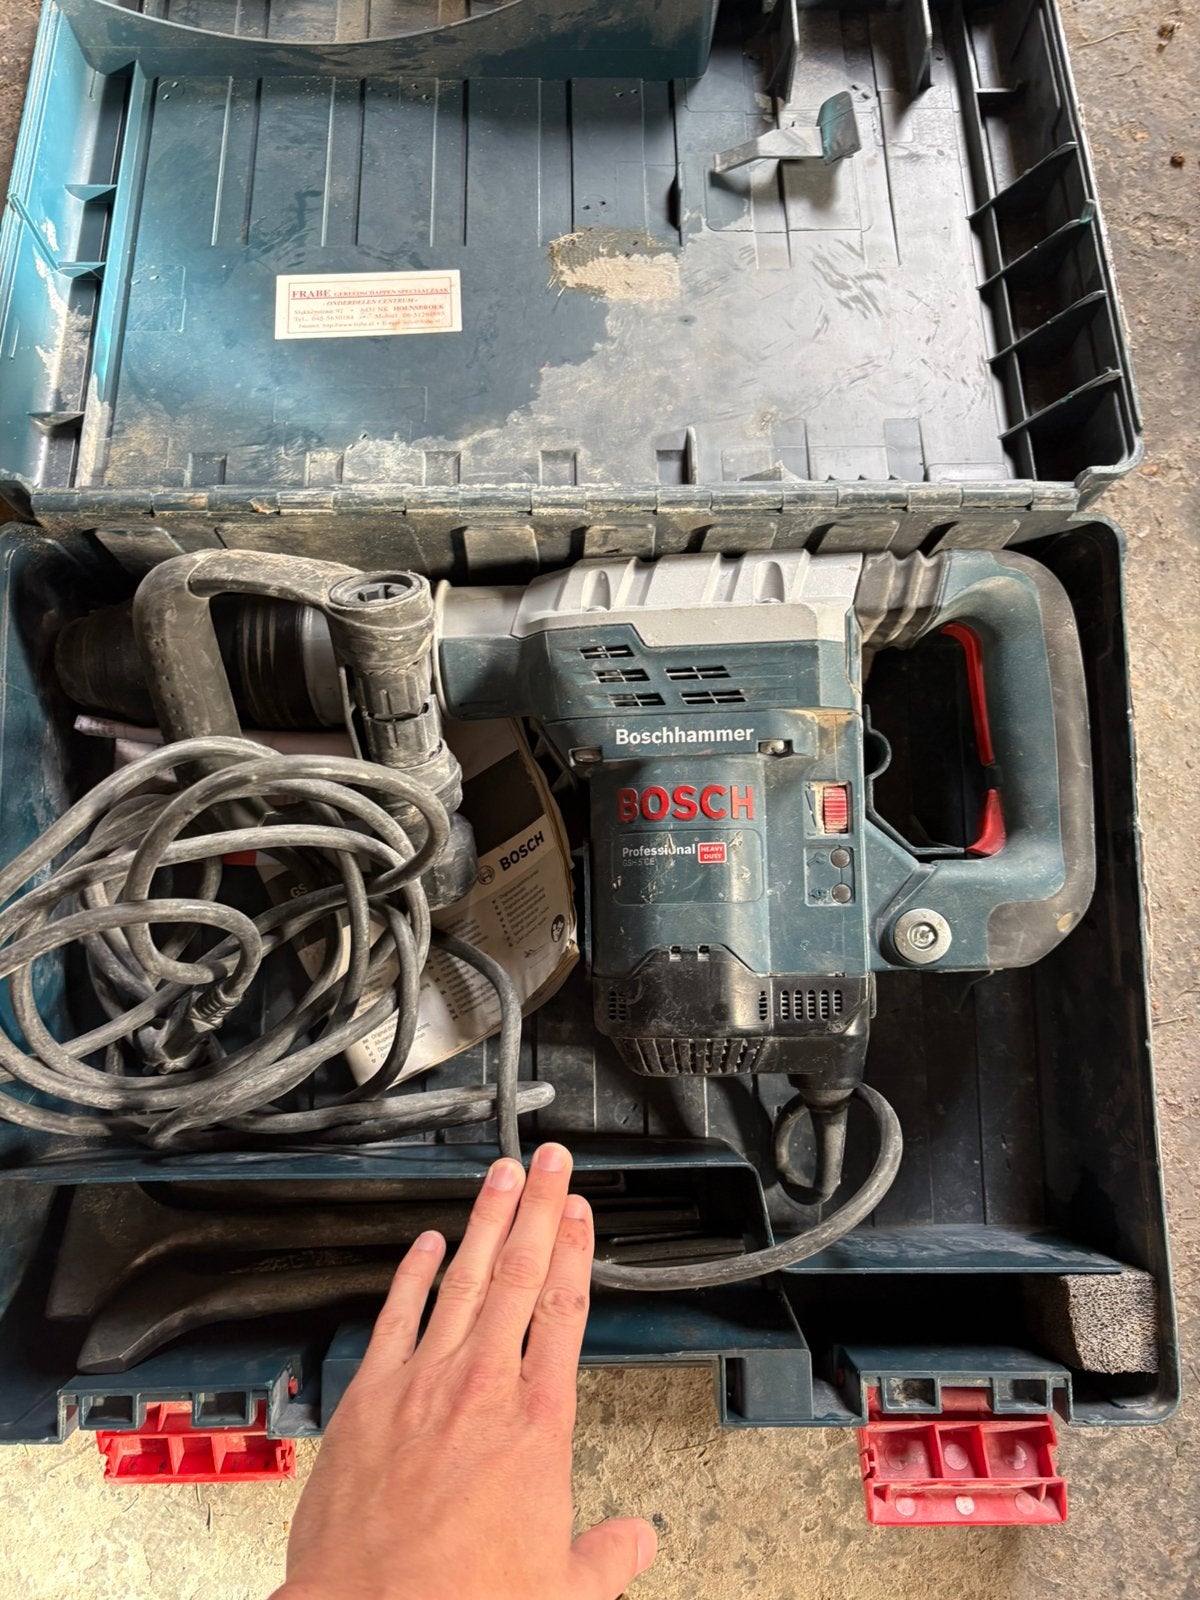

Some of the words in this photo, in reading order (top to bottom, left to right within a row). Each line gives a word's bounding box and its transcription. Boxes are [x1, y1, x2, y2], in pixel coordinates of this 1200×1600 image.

[292, 289, 331, 299] FRABE
[616, 726, 754, 745] Boschhammer
[617, 783, 755, 823] BOSCH
[499, 830, 545, 871] BOSCH
[622, 842, 696, 858] Professional
[289, 882, 308, 898] GS
